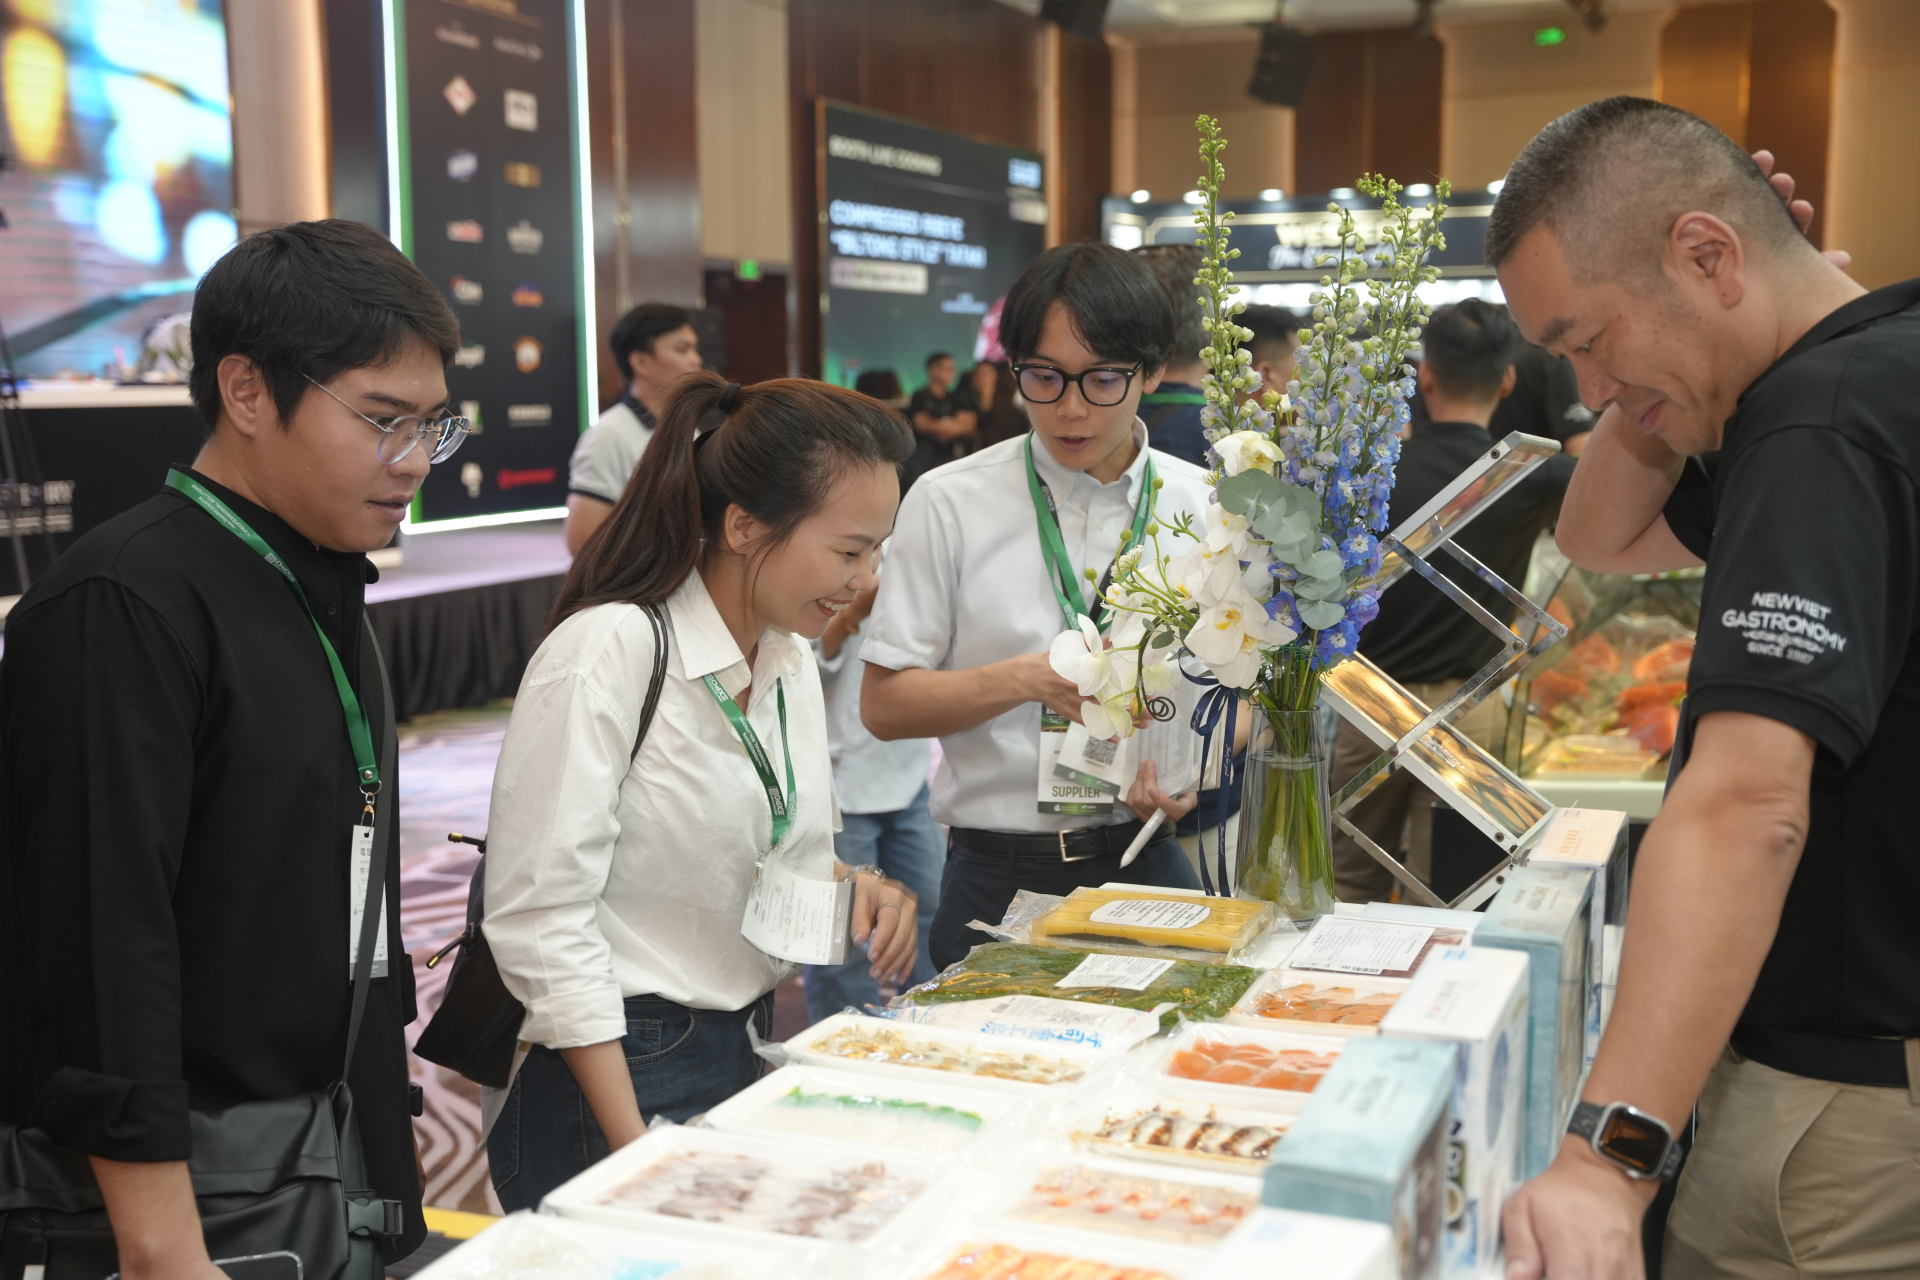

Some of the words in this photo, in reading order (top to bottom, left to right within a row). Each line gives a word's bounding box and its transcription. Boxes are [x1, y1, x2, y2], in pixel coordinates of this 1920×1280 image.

[191, 484, 216, 504] SOLUTIONS
[215, 502, 249, 534] PROFESSIONAL
[1721, 609, 1847, 652] GASTRONOMY
[1747, 642, 1784, 658] SINCE
[1052, 785, 1100, 798] SUPPLIER
